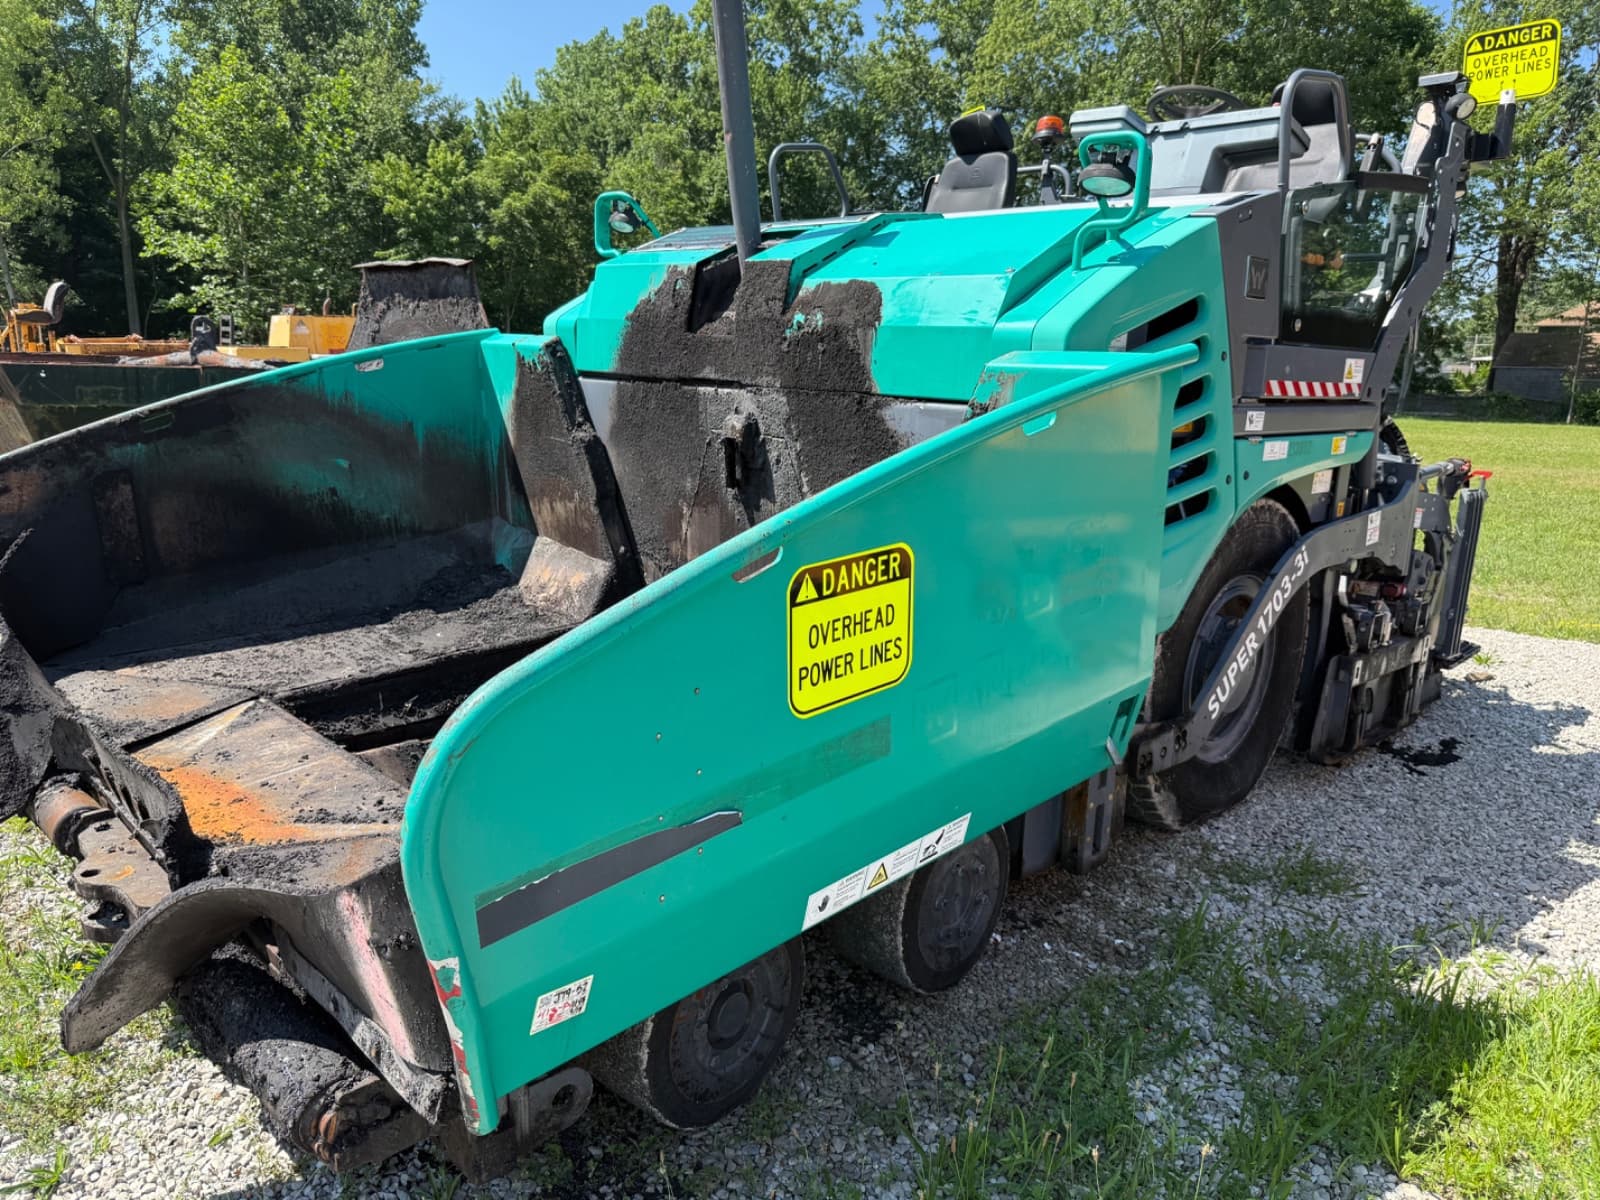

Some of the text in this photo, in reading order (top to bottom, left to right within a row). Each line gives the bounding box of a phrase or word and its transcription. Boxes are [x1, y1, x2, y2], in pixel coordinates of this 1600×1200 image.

[1473, 45, 1548, 69] OVERHEAD
[1484, 25, 1553, 50] DANGER
[1468, 57, 1552, 81] POWER LINES
[822, 552, 901, 597] DANGER
[808, 603, 895, 650] OVERHEAD
[1208, 544, 1310, 720] SUPER 1703-3i
[799, 637, 903, 692] POWER LINES
